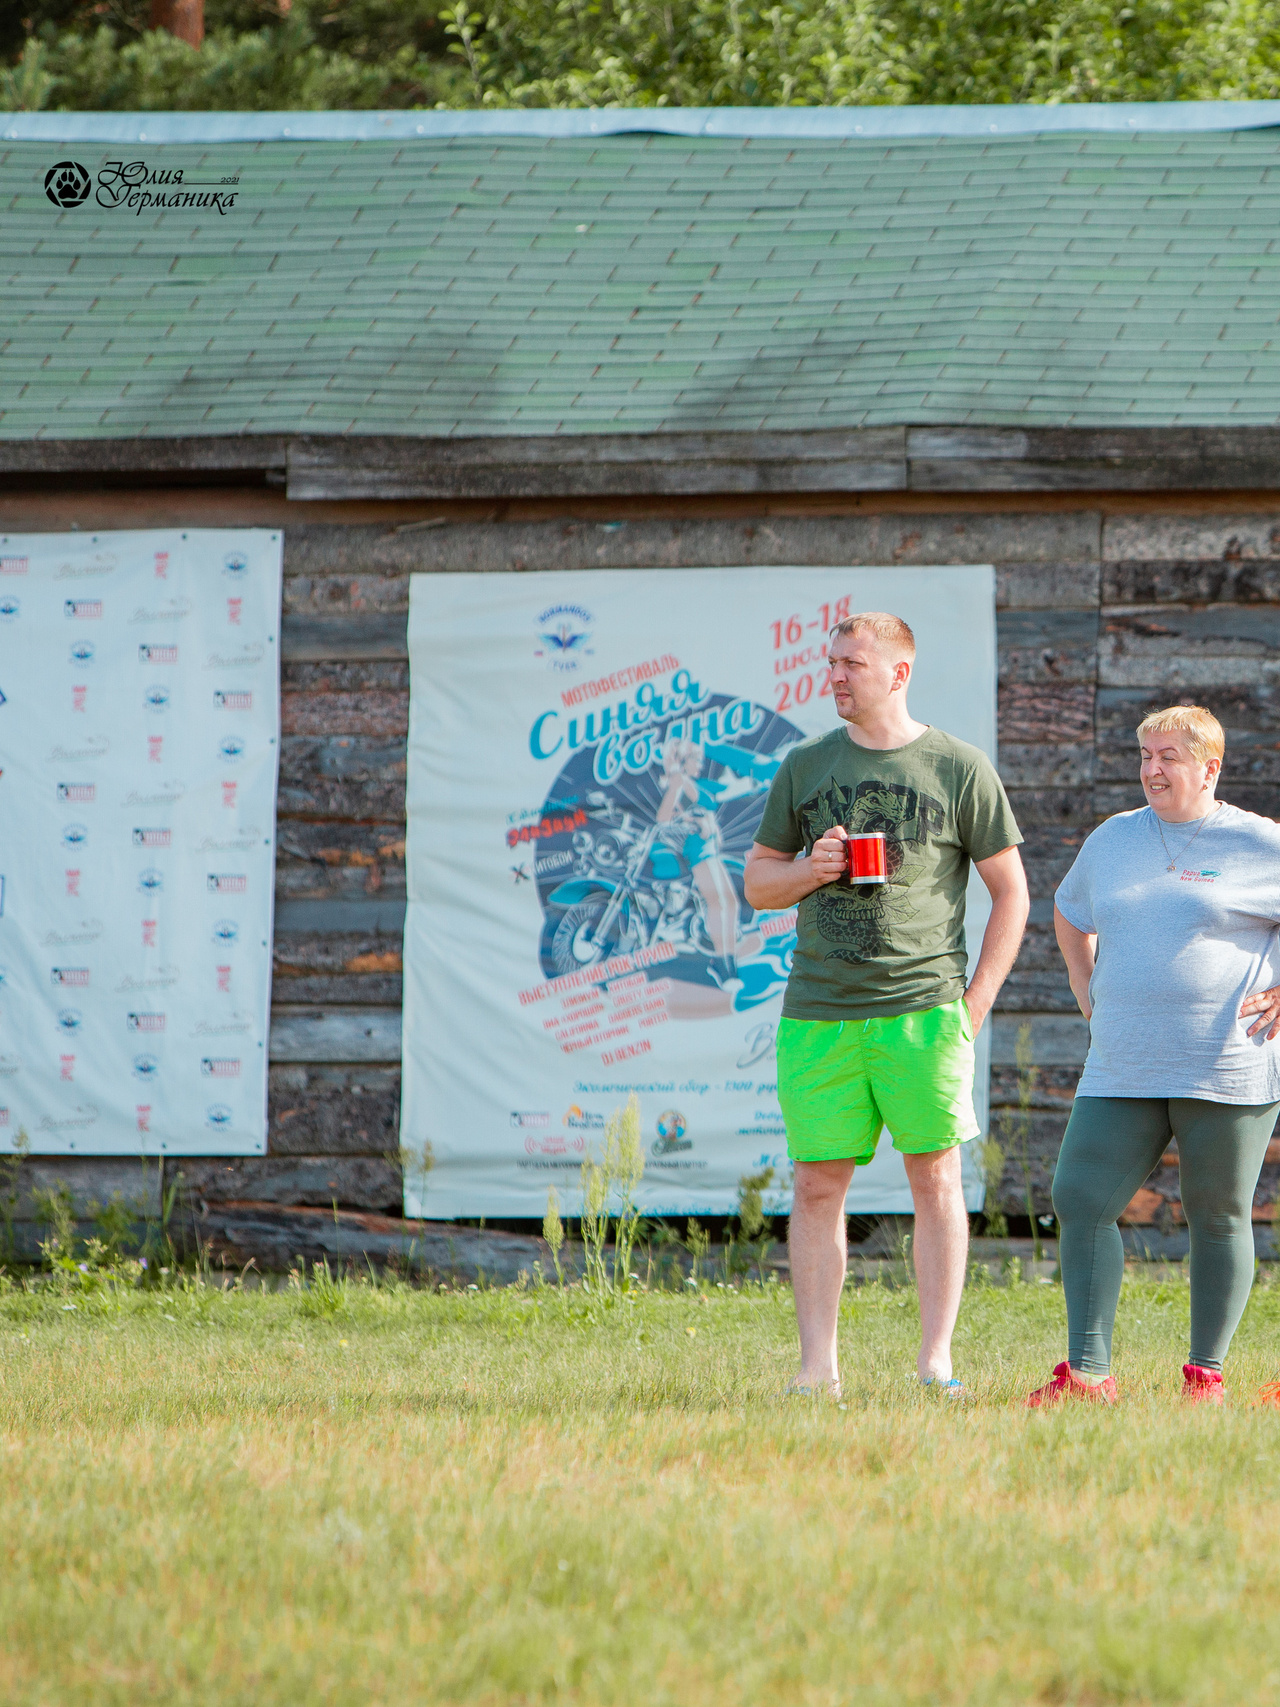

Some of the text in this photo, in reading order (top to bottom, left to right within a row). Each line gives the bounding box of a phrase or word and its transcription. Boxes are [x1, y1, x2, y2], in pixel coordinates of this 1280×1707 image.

[770, 594, 852, 650] 16-18
[561, 653, 680, 709] МОТОФЕСТИВАЛЬ
[774, 643, 829, 675] июл
[529, 669, 709, 760] Синяя
[774, 667, 832, 712] 202
[760, 914, 797, 938] ВОДН
[518, 941, 675, 1006] ВЫСТУПЛЕНИЕ РОК-ГРУПП
[601, 1051, 614, 1067] DJ
